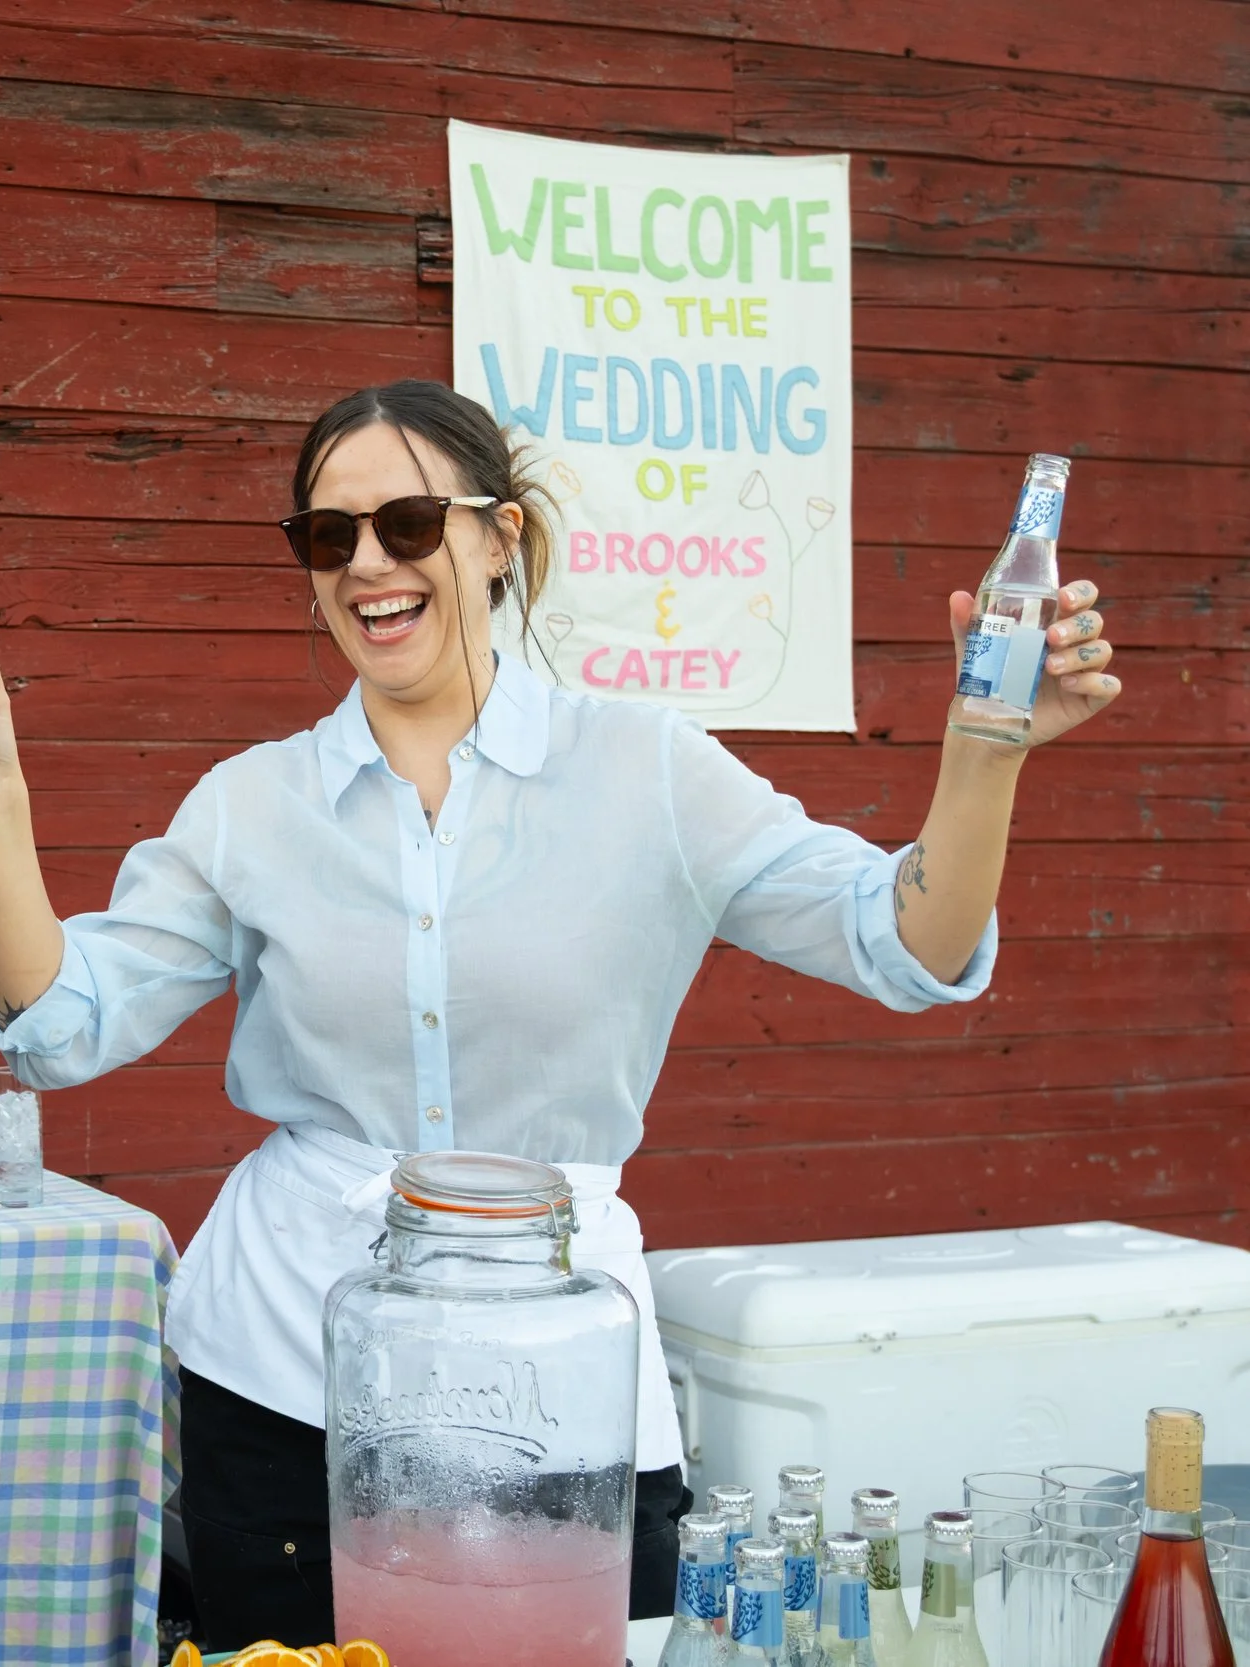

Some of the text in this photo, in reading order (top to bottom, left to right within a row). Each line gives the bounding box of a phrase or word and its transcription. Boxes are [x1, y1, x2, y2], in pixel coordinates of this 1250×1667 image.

[470, 163, 833, 283] WELCOME
[572, 285, 768, 338] TO THE
[480, 343, 827, 455] WEDDING
[636, 457, 708, 505] OF
[568, 531, 766, 577] BROOKS
[654, 581, 681, 646] &
[581, 647, 741, 689] CATEY
